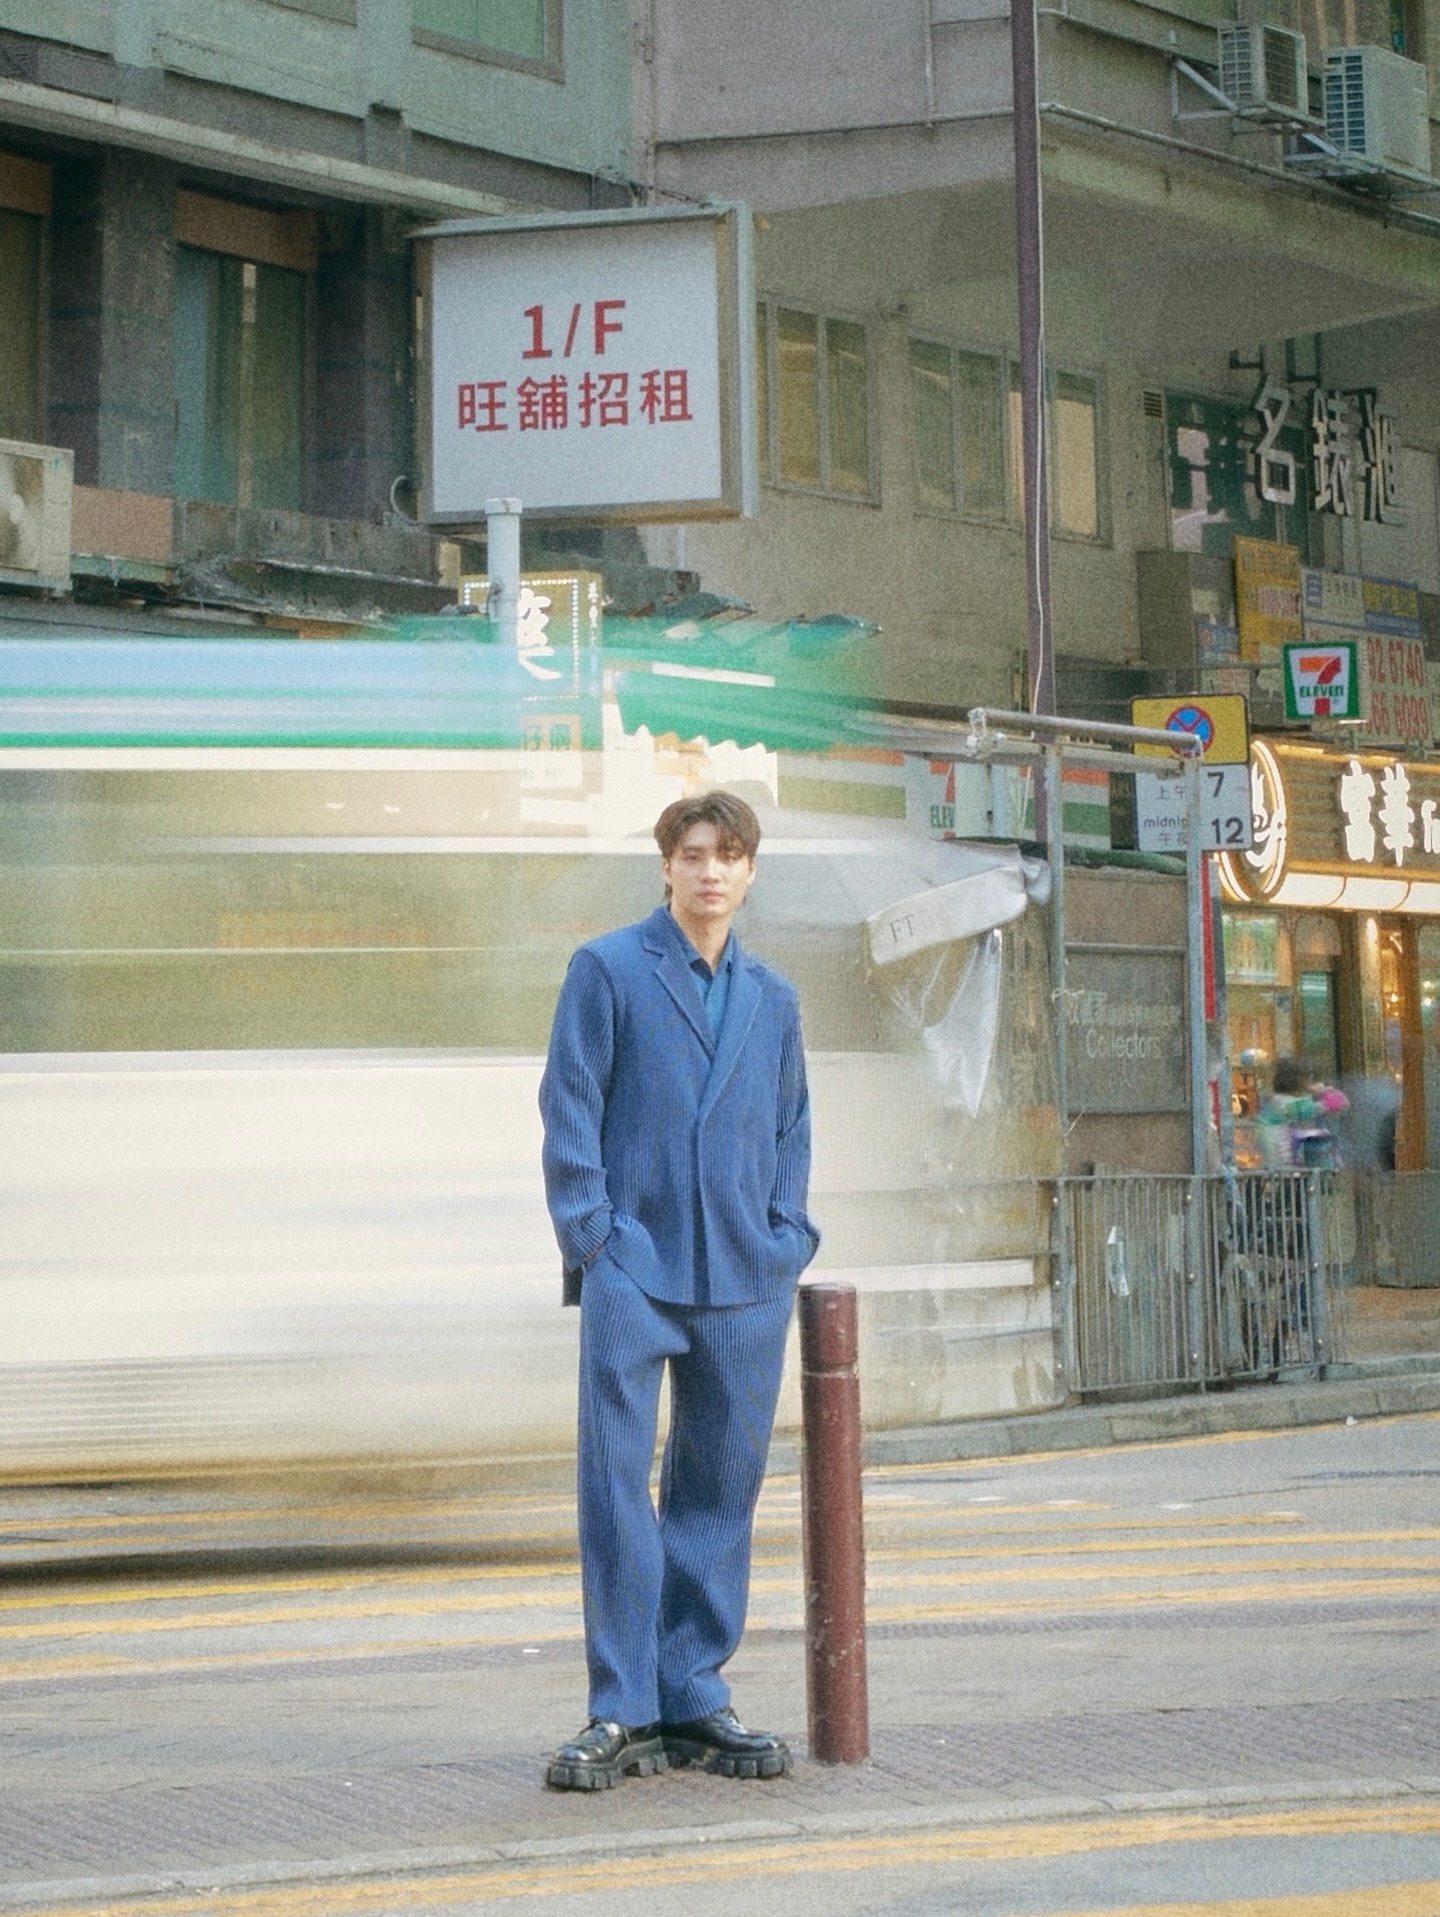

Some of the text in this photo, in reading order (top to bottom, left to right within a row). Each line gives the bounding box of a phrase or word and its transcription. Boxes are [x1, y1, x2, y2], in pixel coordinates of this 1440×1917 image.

[520, 300, 626, 360] 1/F
[457, 368, 694, 432] 旺舖招租
[1299, 656, 1341, 684] 7
[1156, 784, 1189, 801] 上午
[1207, 771, 1225, 798] 7
[1211, 817, 1244, 844] 12
